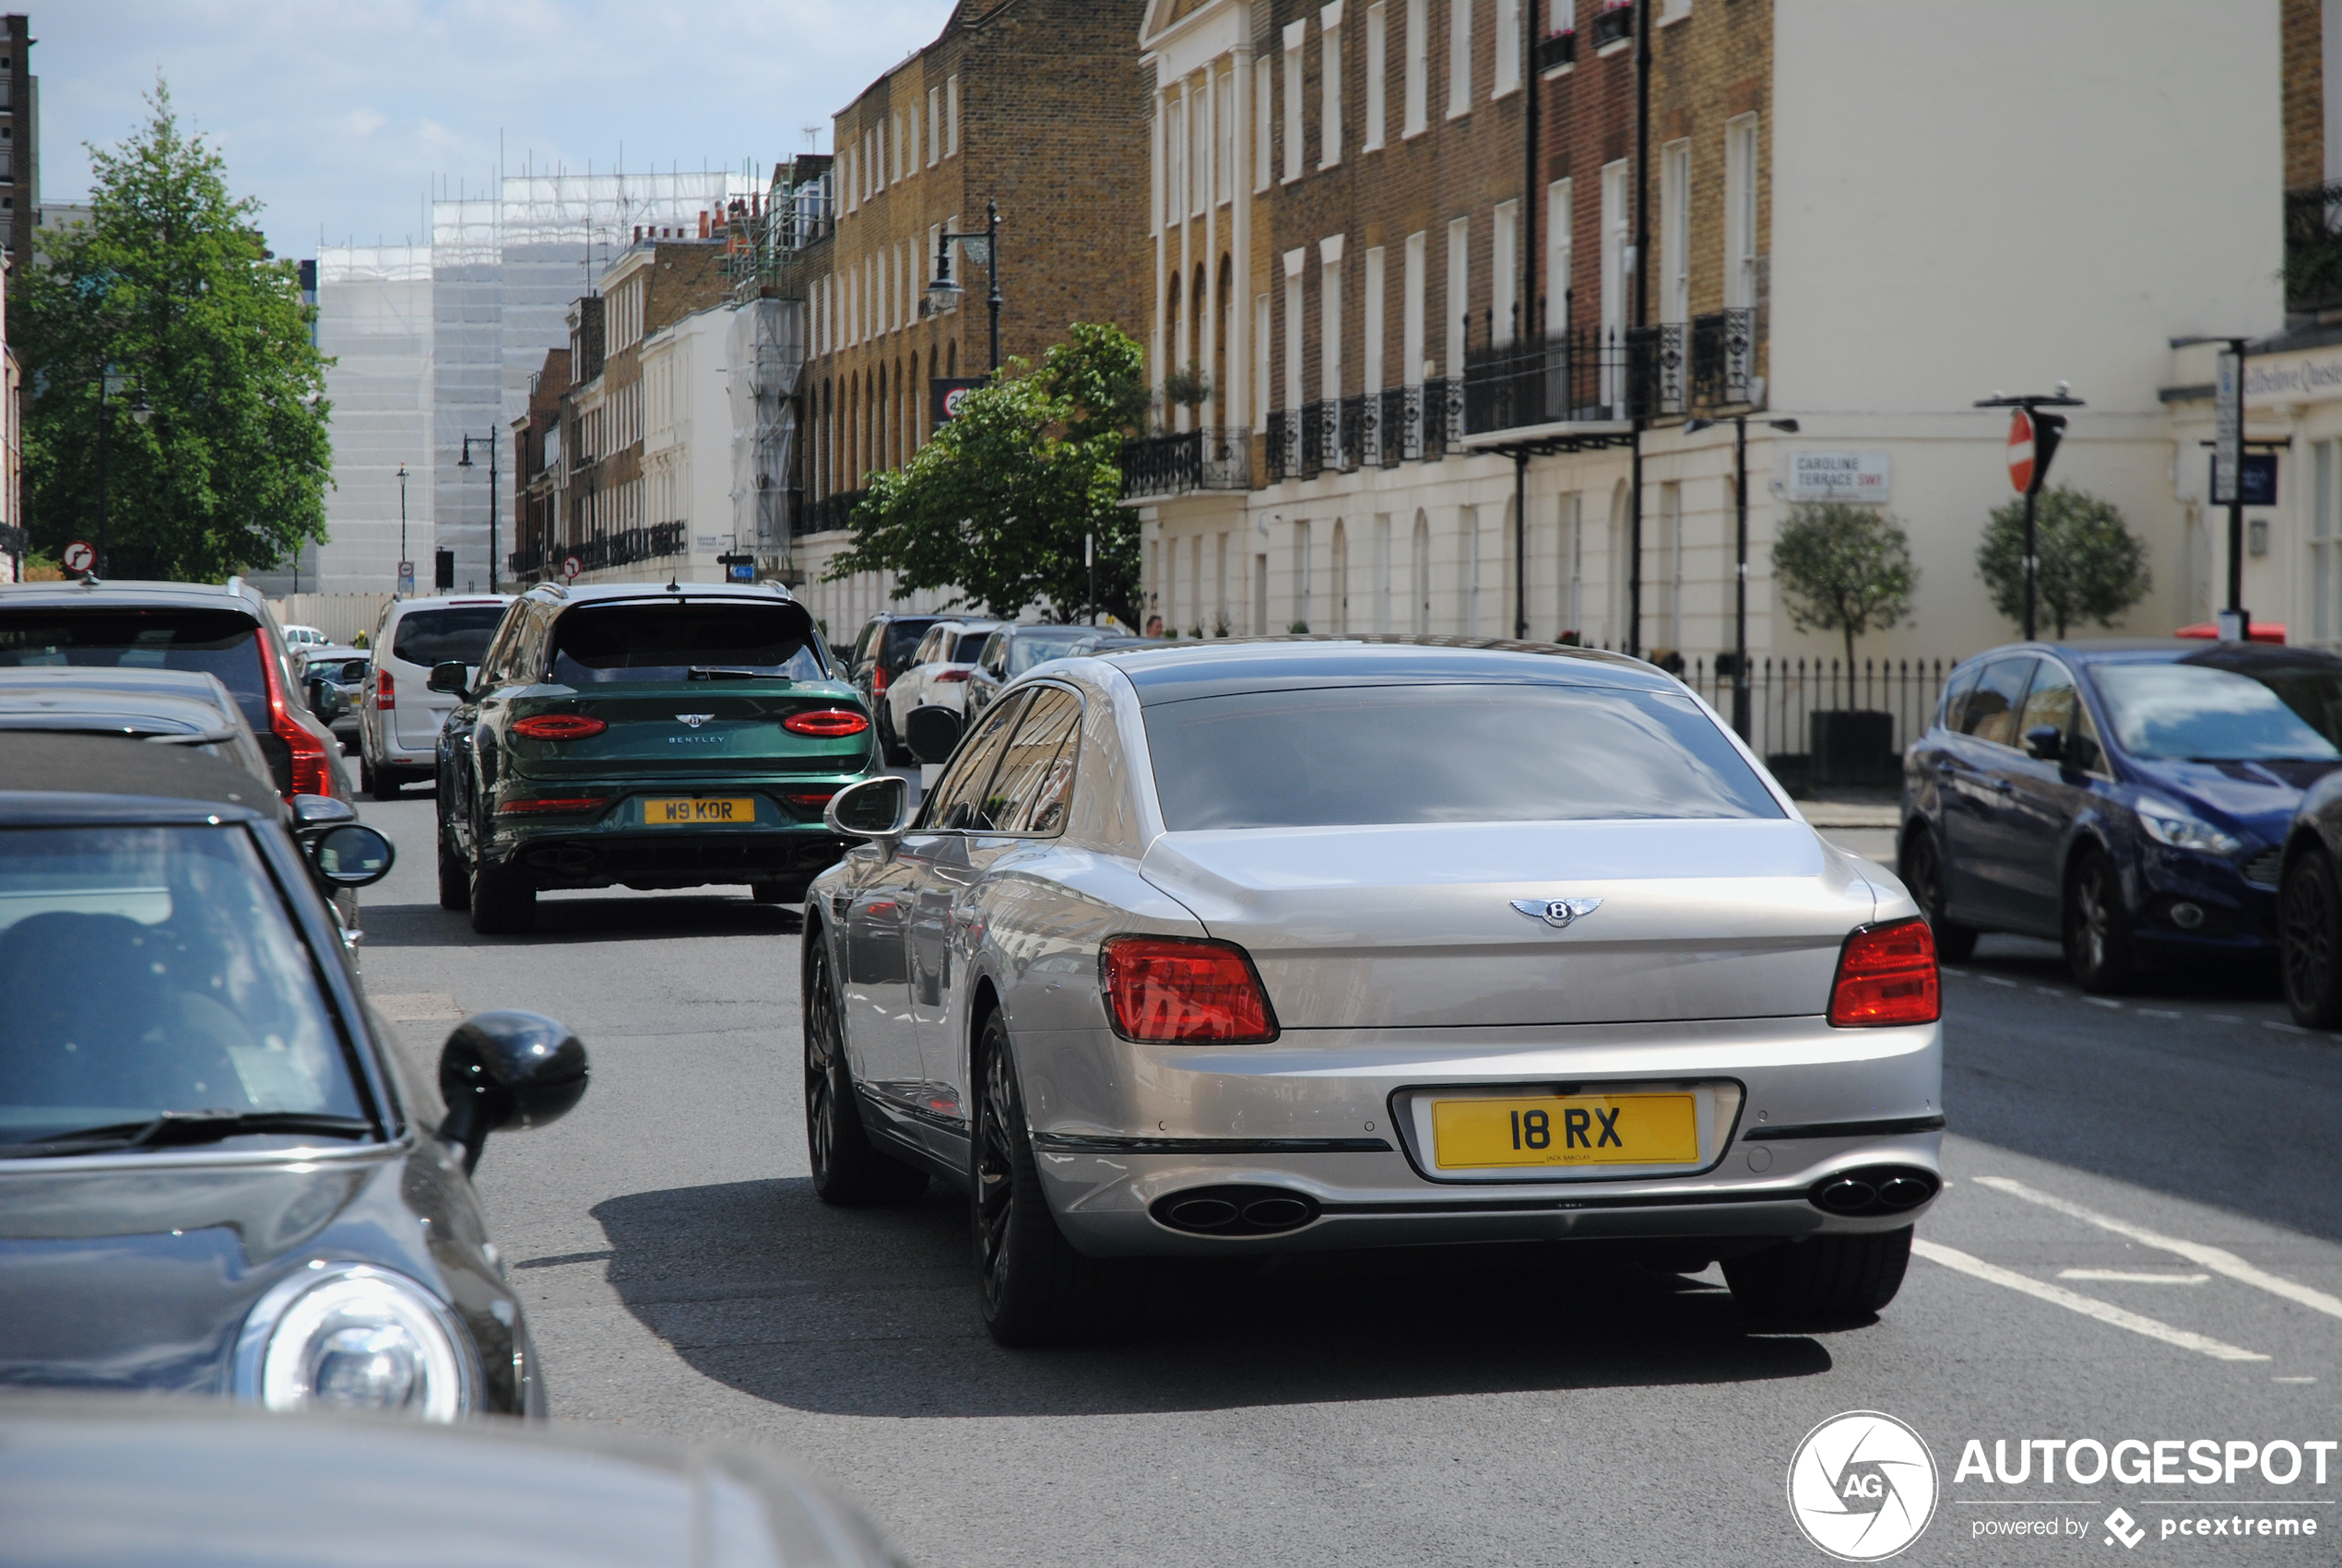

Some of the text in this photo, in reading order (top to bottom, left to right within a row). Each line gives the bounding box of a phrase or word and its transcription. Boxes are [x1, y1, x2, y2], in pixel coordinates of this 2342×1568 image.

[2244, 363, 2300, 394] ellbelove
[1797, 457, 1859, 470] CAROLINE
[1798, 472, 1852, 486] TERRACE
[1857, 473, 1883, 487] SW1
[666, 802, 732, 819] W9 KOR
[1550, 903, 1567, 918] B
[1510, 1107, 1623, 1150] 18 RX
